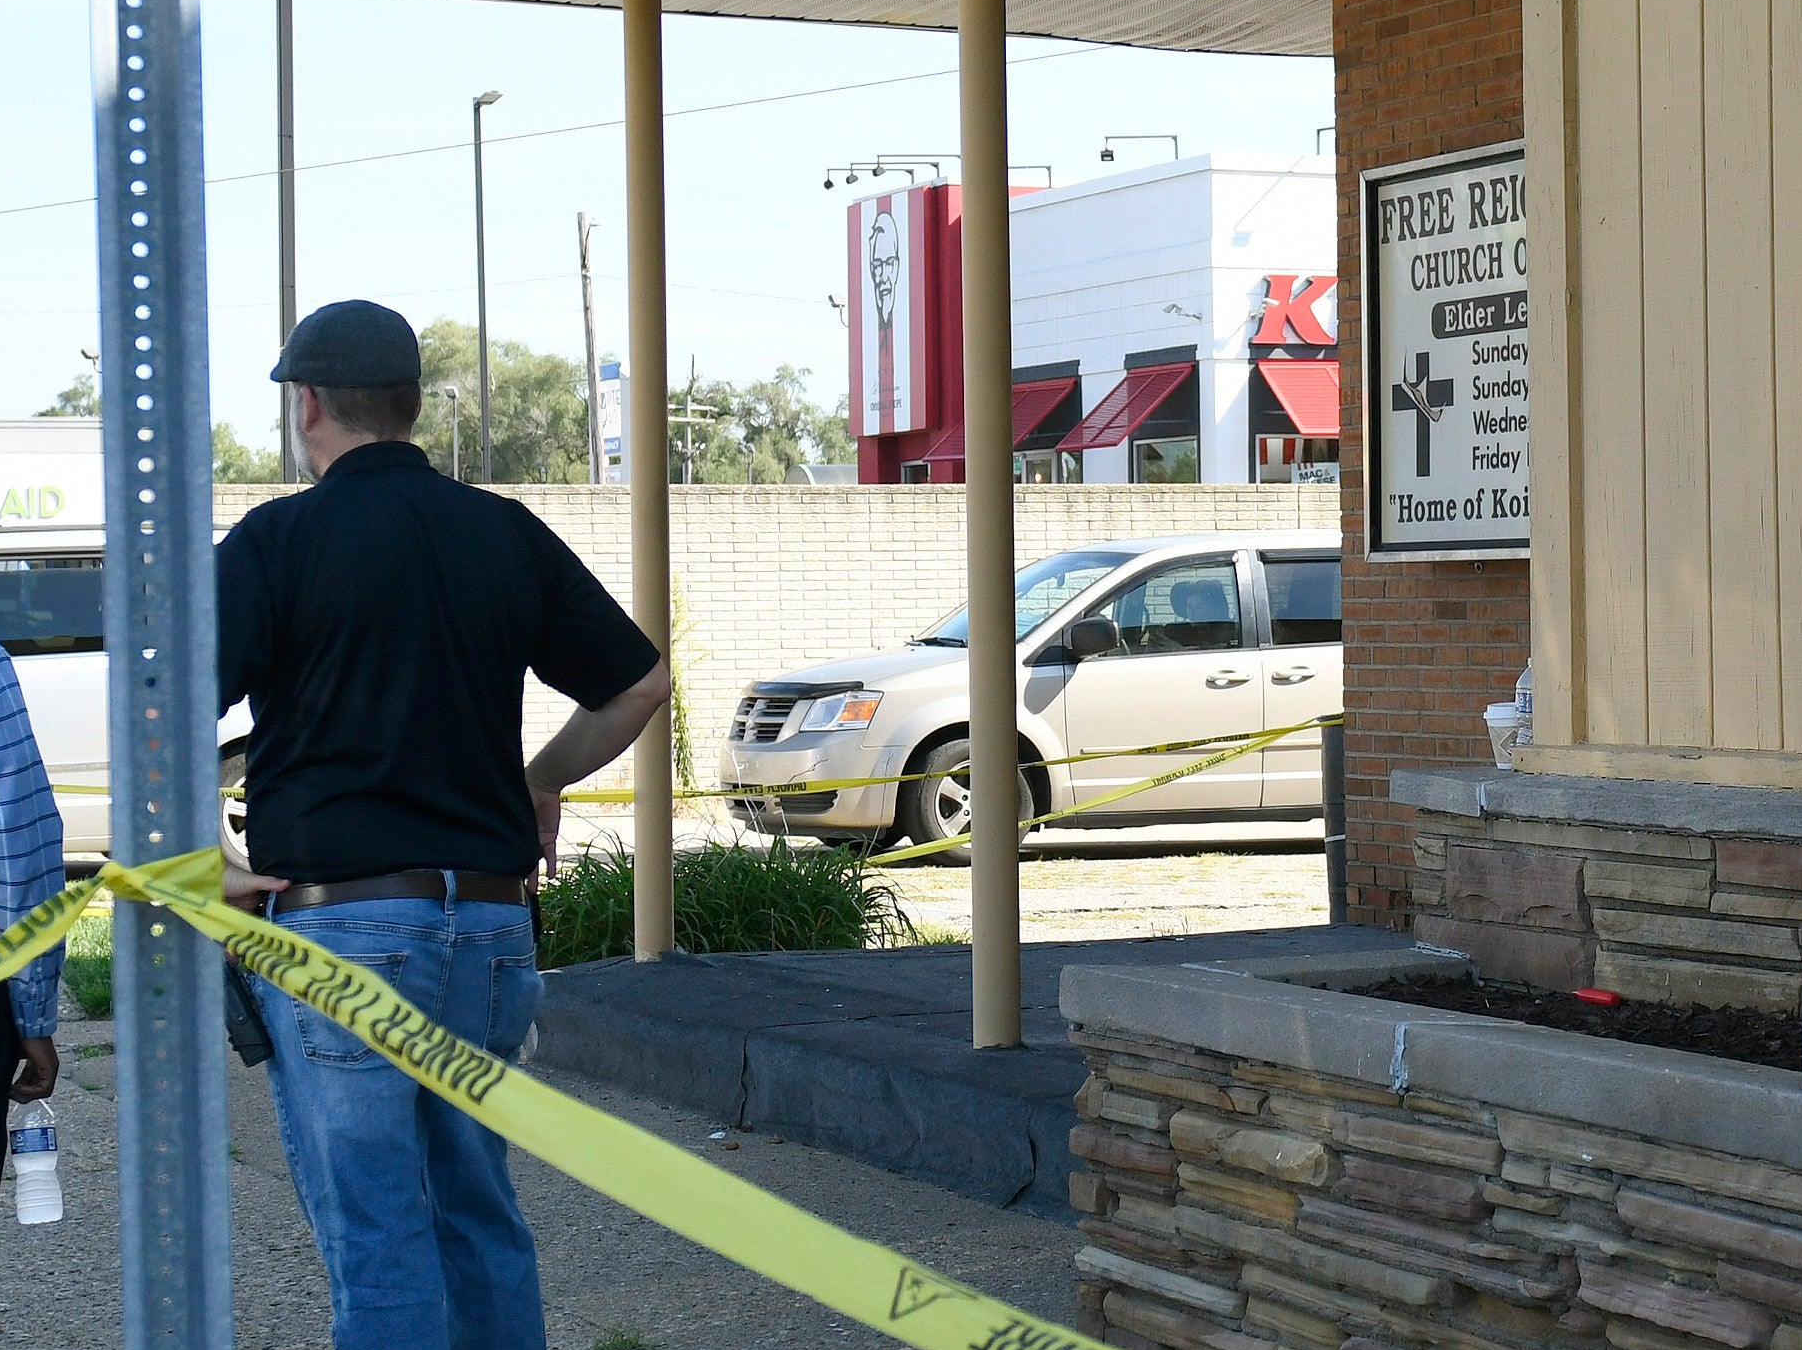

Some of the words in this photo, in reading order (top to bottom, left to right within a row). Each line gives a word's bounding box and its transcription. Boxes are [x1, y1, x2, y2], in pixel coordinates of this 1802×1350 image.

[1380, 187, 1455, 245] FREE
[1410, 241, 1504, 292] CHURCH
[1444, 301, 1496, 332] Elder
[1472, 334, 1529, 366] Sunday
[1472, 370, 1529, 402] Sunday
[1472, 405, 1530, 436] Wedne
[1472, 441, 1522, 474] Friday
[1298, 469, 1324, 481] MAC
[1462, 487, 1485, 521] of
[369, 1002, 506, 1106] DANGER
